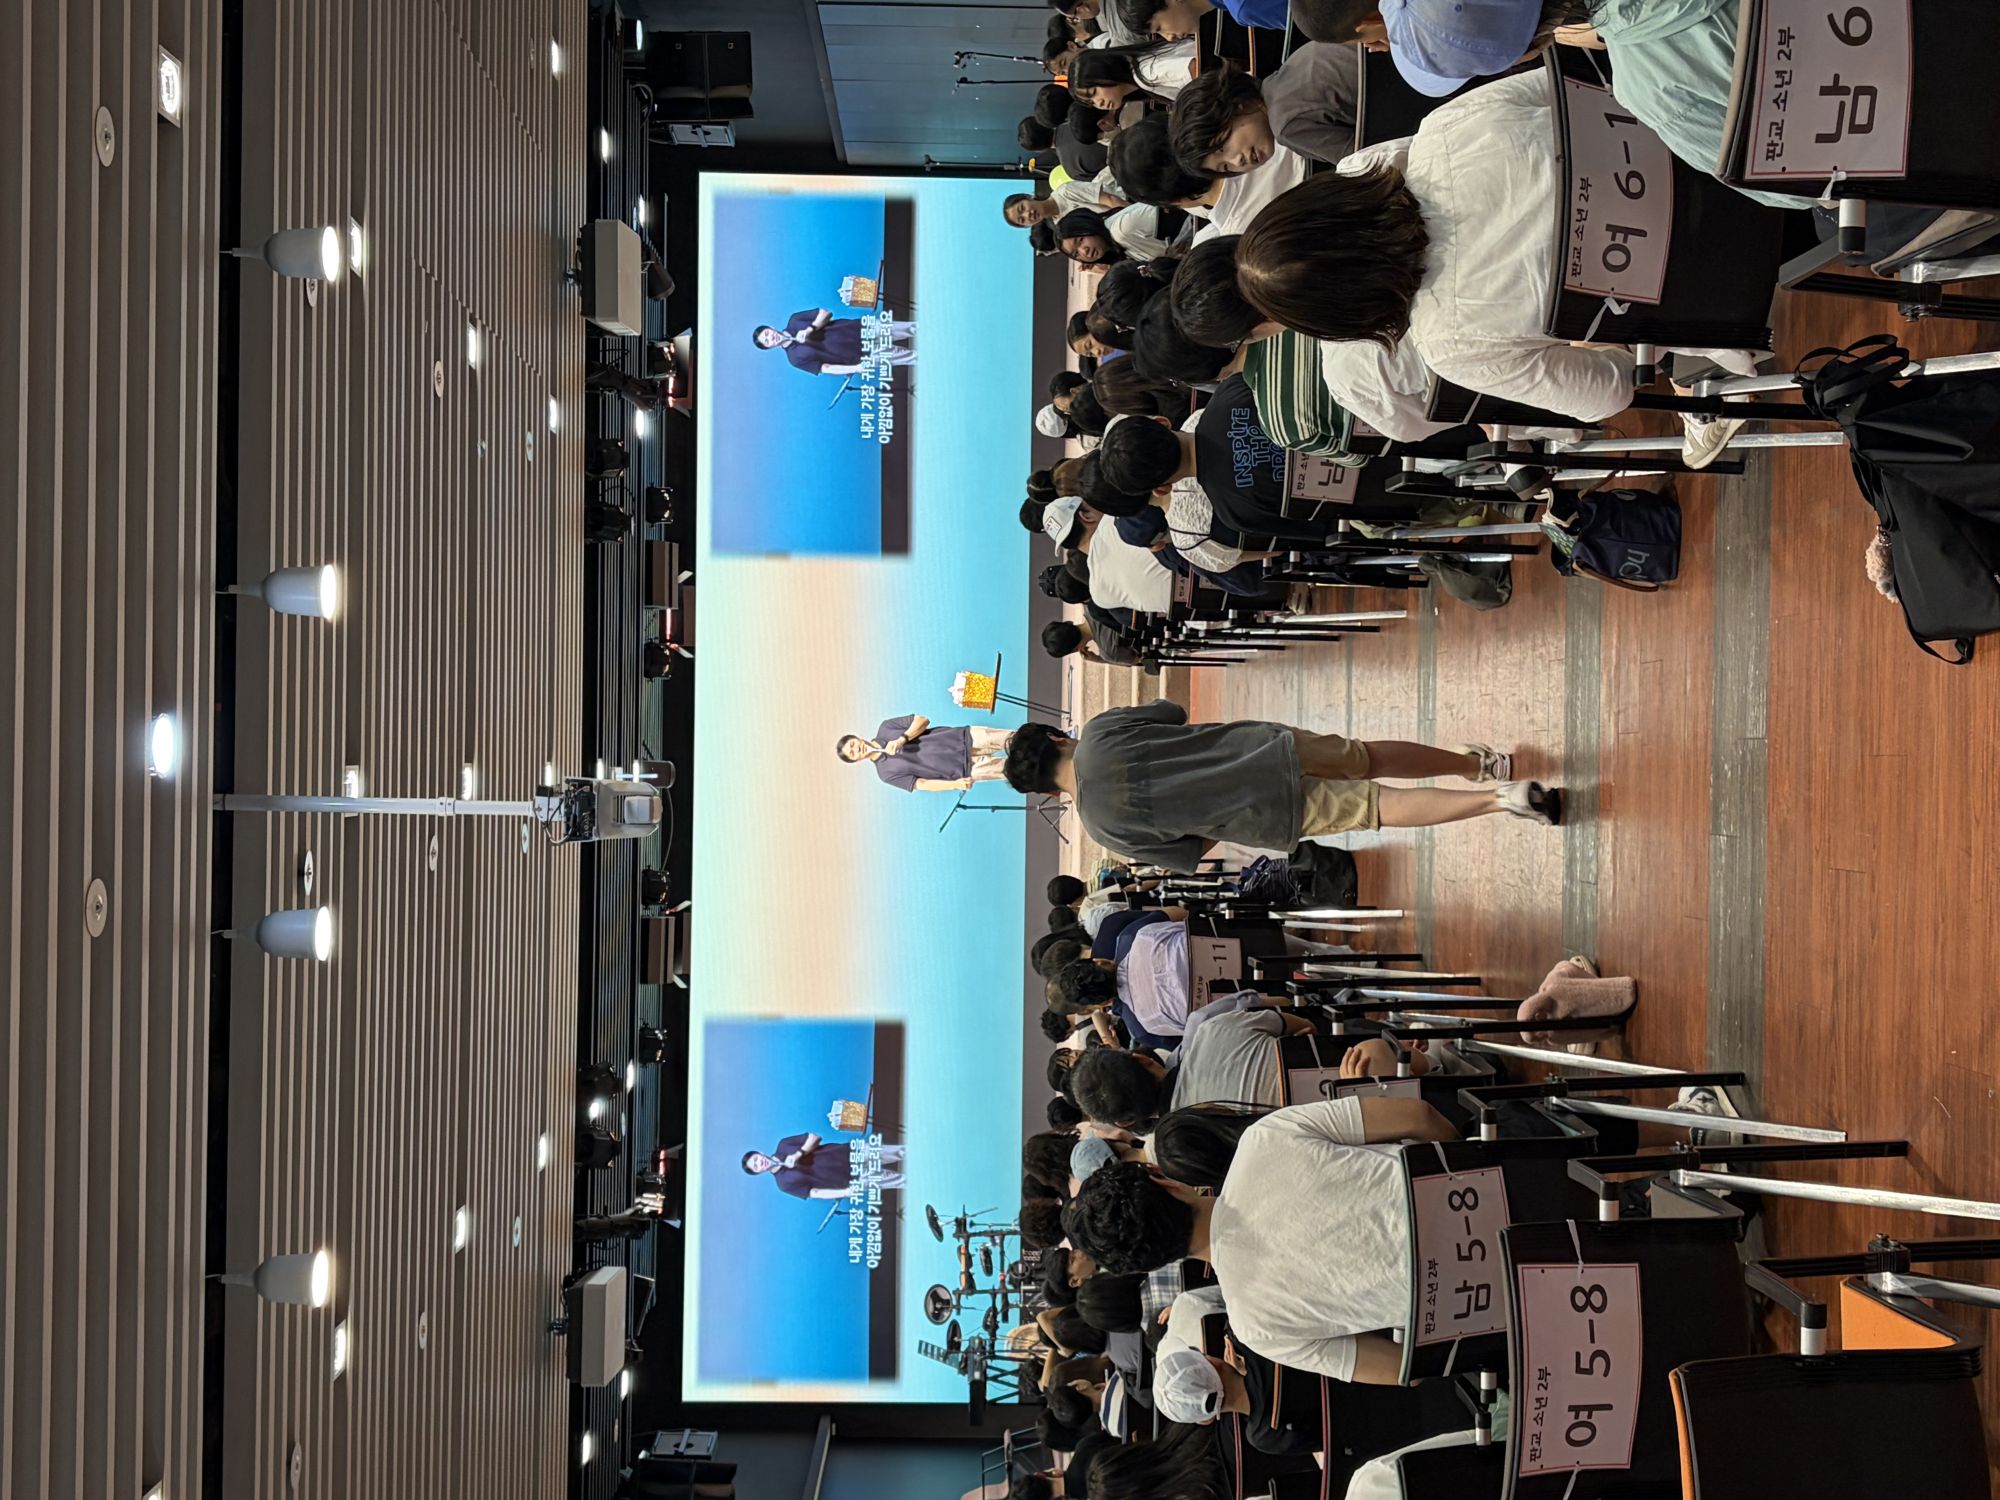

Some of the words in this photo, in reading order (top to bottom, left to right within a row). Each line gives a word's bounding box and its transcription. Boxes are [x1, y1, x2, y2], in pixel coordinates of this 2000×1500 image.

[1776, 26, 1796, 62] 2부
[1826, 6, 1873, 47] 6
[1772, 69, 1793, 113] 소년
[1814, 72, 1878, 144] 남
[1603, 112, 1646, 200] 6-1
[1765, 118, 1785, 162] 판교
[1578, 176, 1592, 203] 2부
[1573, 208, 1588, 242] 소년
[1570, 246, 1582, 278] 판교
[1601, 223, 1648, 273] 여
[861, 315, 876, 352] 보물을
[879, 310, 893, 349] 드려요
[861, 355, 876, 382] 귀한
[878, 352, 893, 390] 기쁘게
[860, 385, 875, 410] 가장
[860, 414, 875, 439] 내게
[878, 393, 893, 444] 아낌없이
[1296, 473, 1306, 490] 판교
[1318, 458, 1345, 487] 남
[1212, 944, 1227, 981] -11
[849, 1138, 865, 1176] 보물을
[867, 1133, 882, 1172] 드려요
[849, 1179, 865, 1206] 귀한
[866, 1175, 882, 1214] 기쁘게
[848, 1208, 864, 1235] 가장
[1447, 1186, 1486, 1262] 5-8
[848, 1238, 864, 1263] 내게
[866, 1217, 882, 1269] 아낌없이
[1427, 1257, 1439, 1278] 2부
[1426, 1282, 1438, 1306] 소년
[1453, 1280, 1491, 1320] 남
[1423, 1310, 1436, 1335] 판교
[1570, 1284, 1611, 1378] 5-8
[1536, 1366, 1551, 1392] 2부
[1531, 1396, 1548, 1427] 소년
[1564, 1403, 1613, 1448] 여
[1529, 1431, 1542, 1463] 판교
